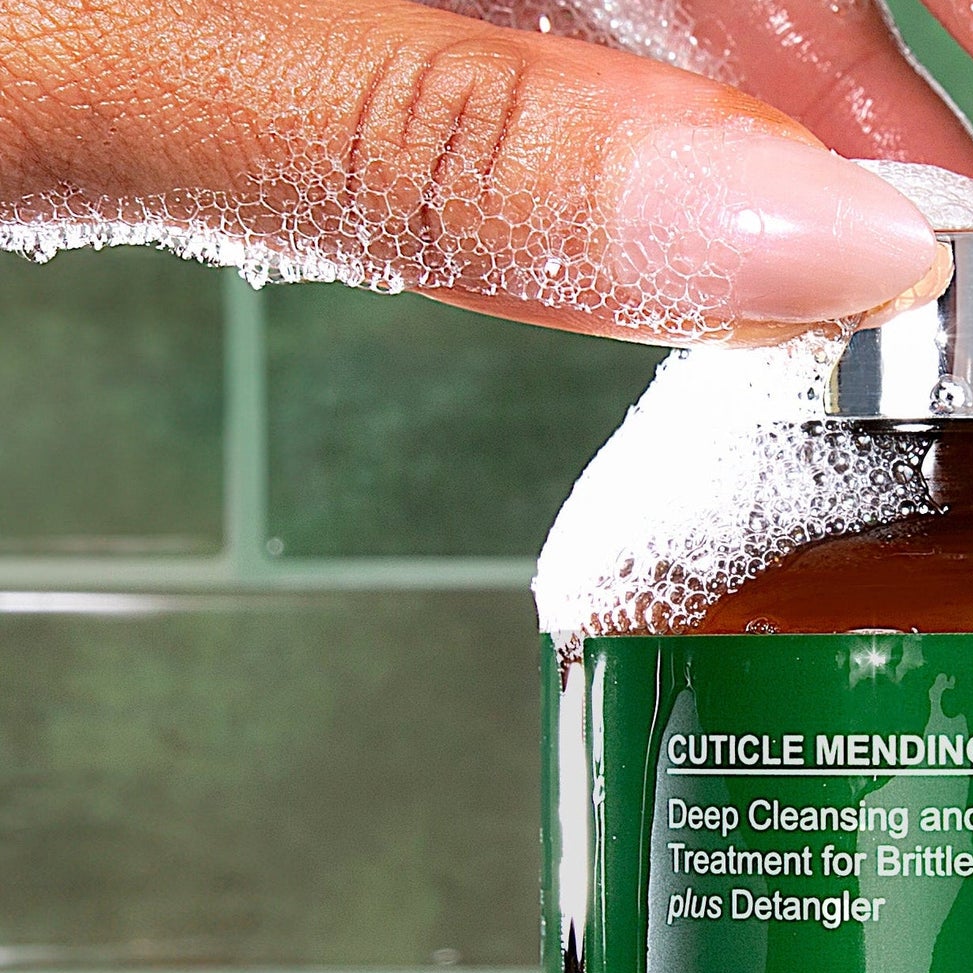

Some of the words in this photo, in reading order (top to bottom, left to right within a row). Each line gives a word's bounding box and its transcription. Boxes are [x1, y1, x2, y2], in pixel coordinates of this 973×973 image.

[667, 734, 805, 766] CUTICLE
[667, 798, 739, 837] Deep
[748, 799, 909, 838] Cleansing
[667, 842, 813, 876] Treatment
[821, 841, 863, 876] for
[666, 890, 722, 922] plus
[731, 889, 887, 929] Detangler
